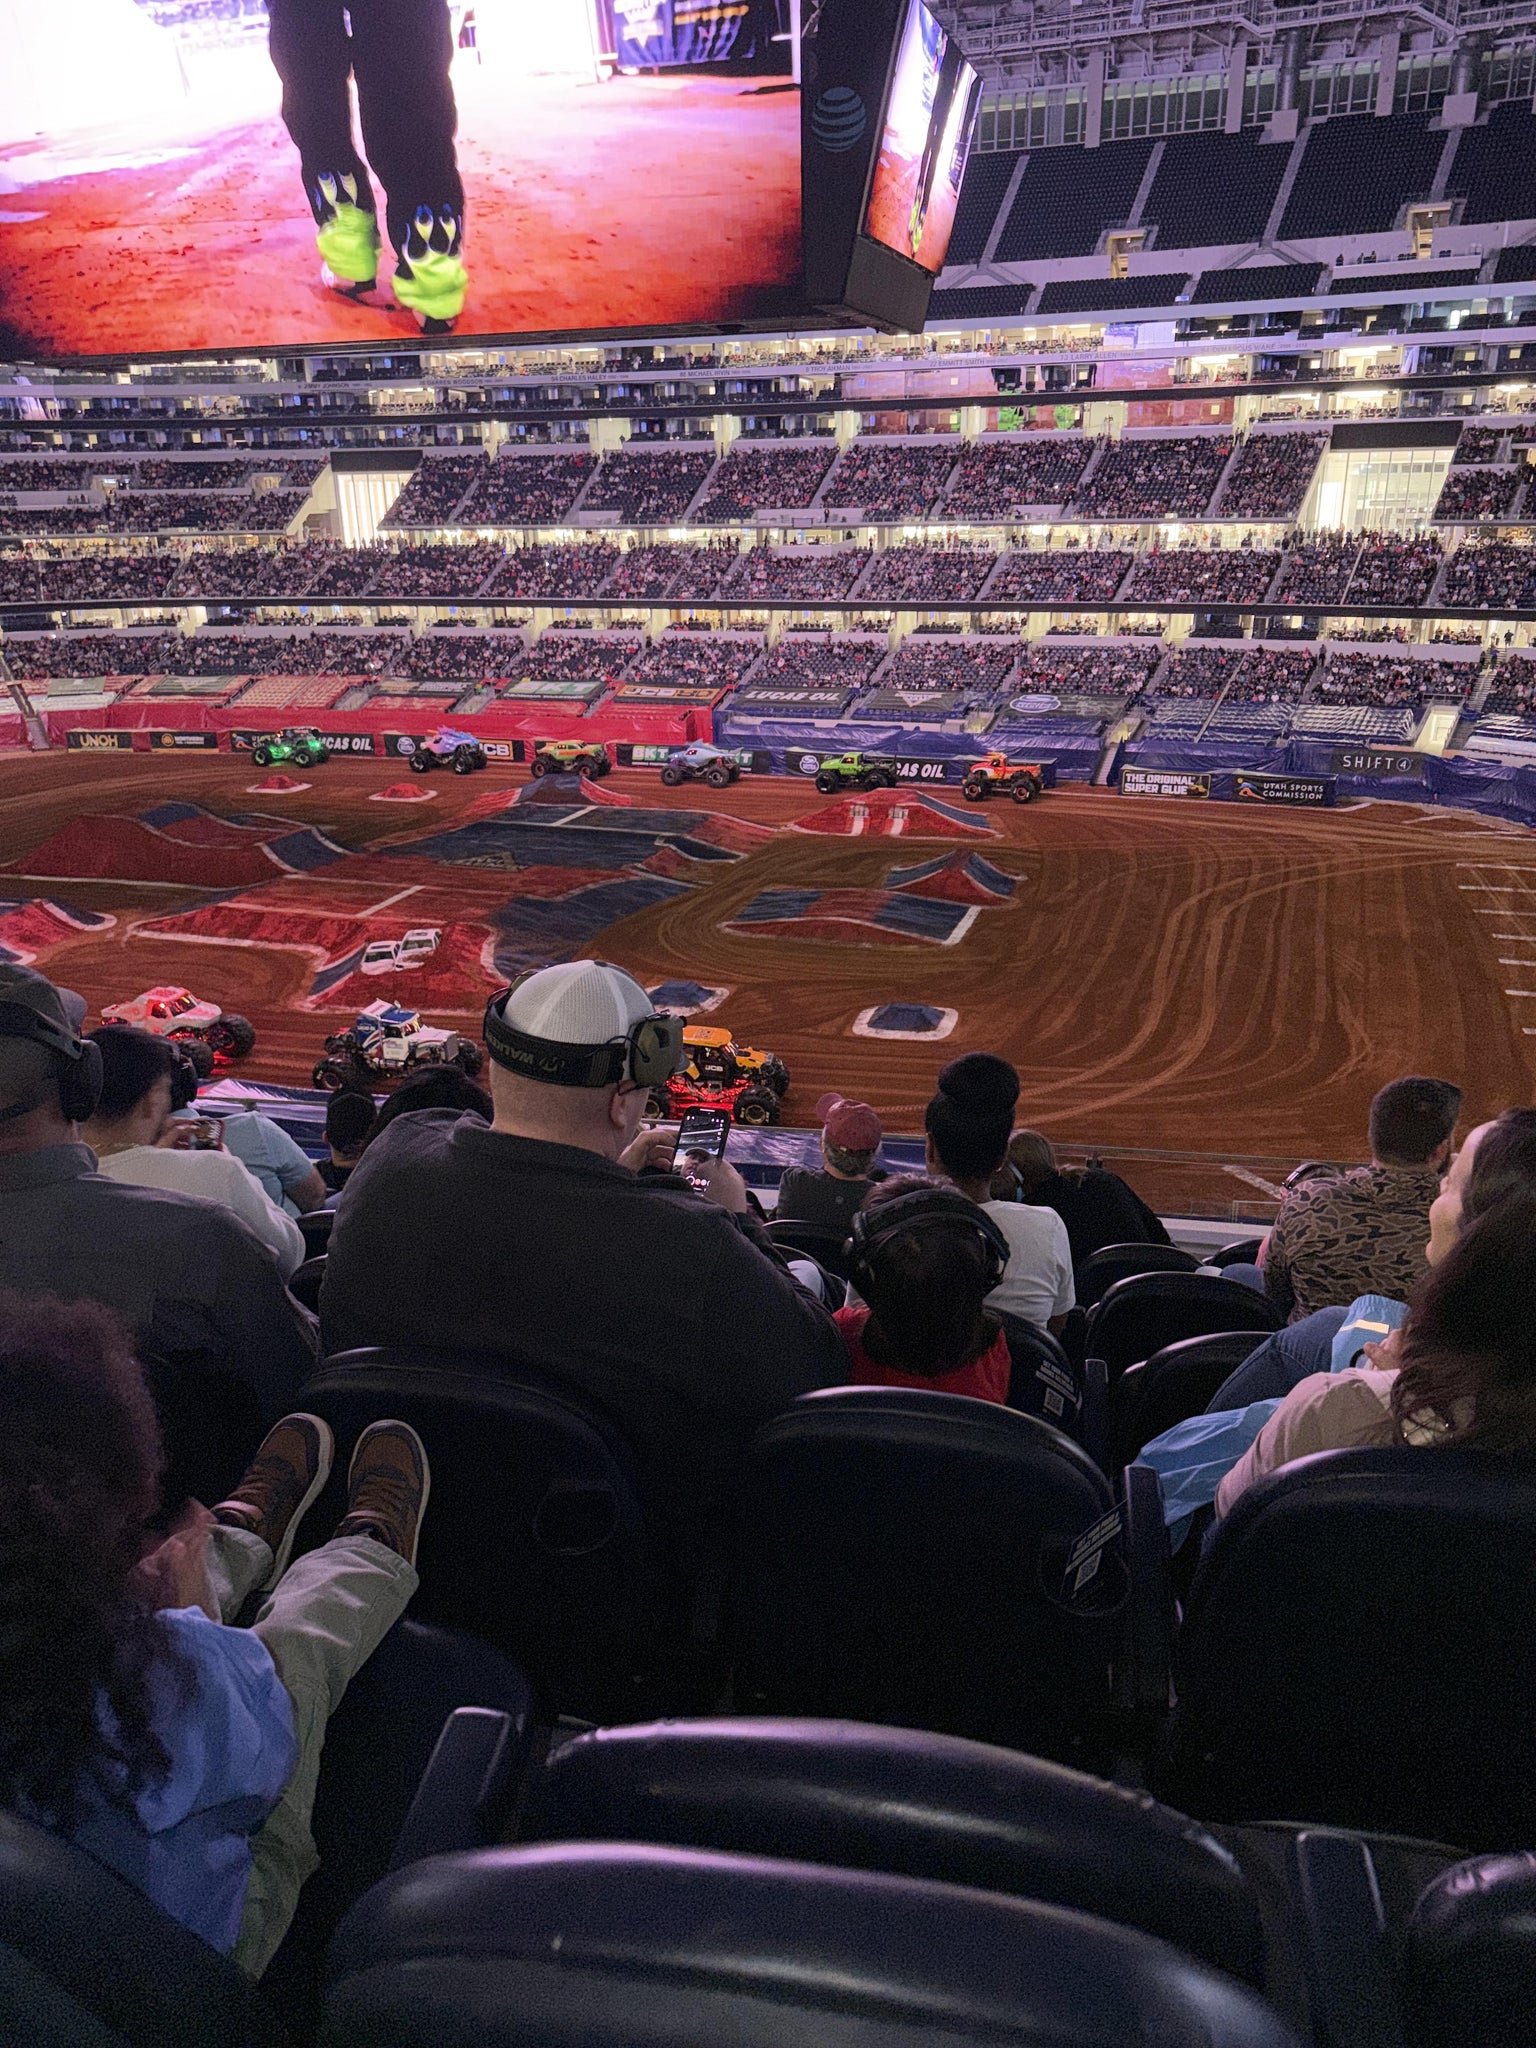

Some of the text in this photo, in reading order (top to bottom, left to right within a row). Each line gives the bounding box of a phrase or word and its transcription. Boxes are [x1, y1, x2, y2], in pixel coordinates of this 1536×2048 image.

[745, 690, 840, 701] LUCAS OIL
[80, 734, 118, 747] UNOH
[351, 738, 372, 751] OIL
[480, 743, 510, 756] CB
[632, 745, 669, 761] BKT
[1342, 755, 1394, 770] SHIFT
[921, 763, 944, 778] OIL
[1125, 773, 1195, 785] THE ORIGINAL
[1125, 783, 1188, 795] SUPER GLUE
[1290, 783, 1324, 792] SPORTS
[1262, 790, 1323, 800] COMMISSION
[704, 1064, 724, 1072] JCB
